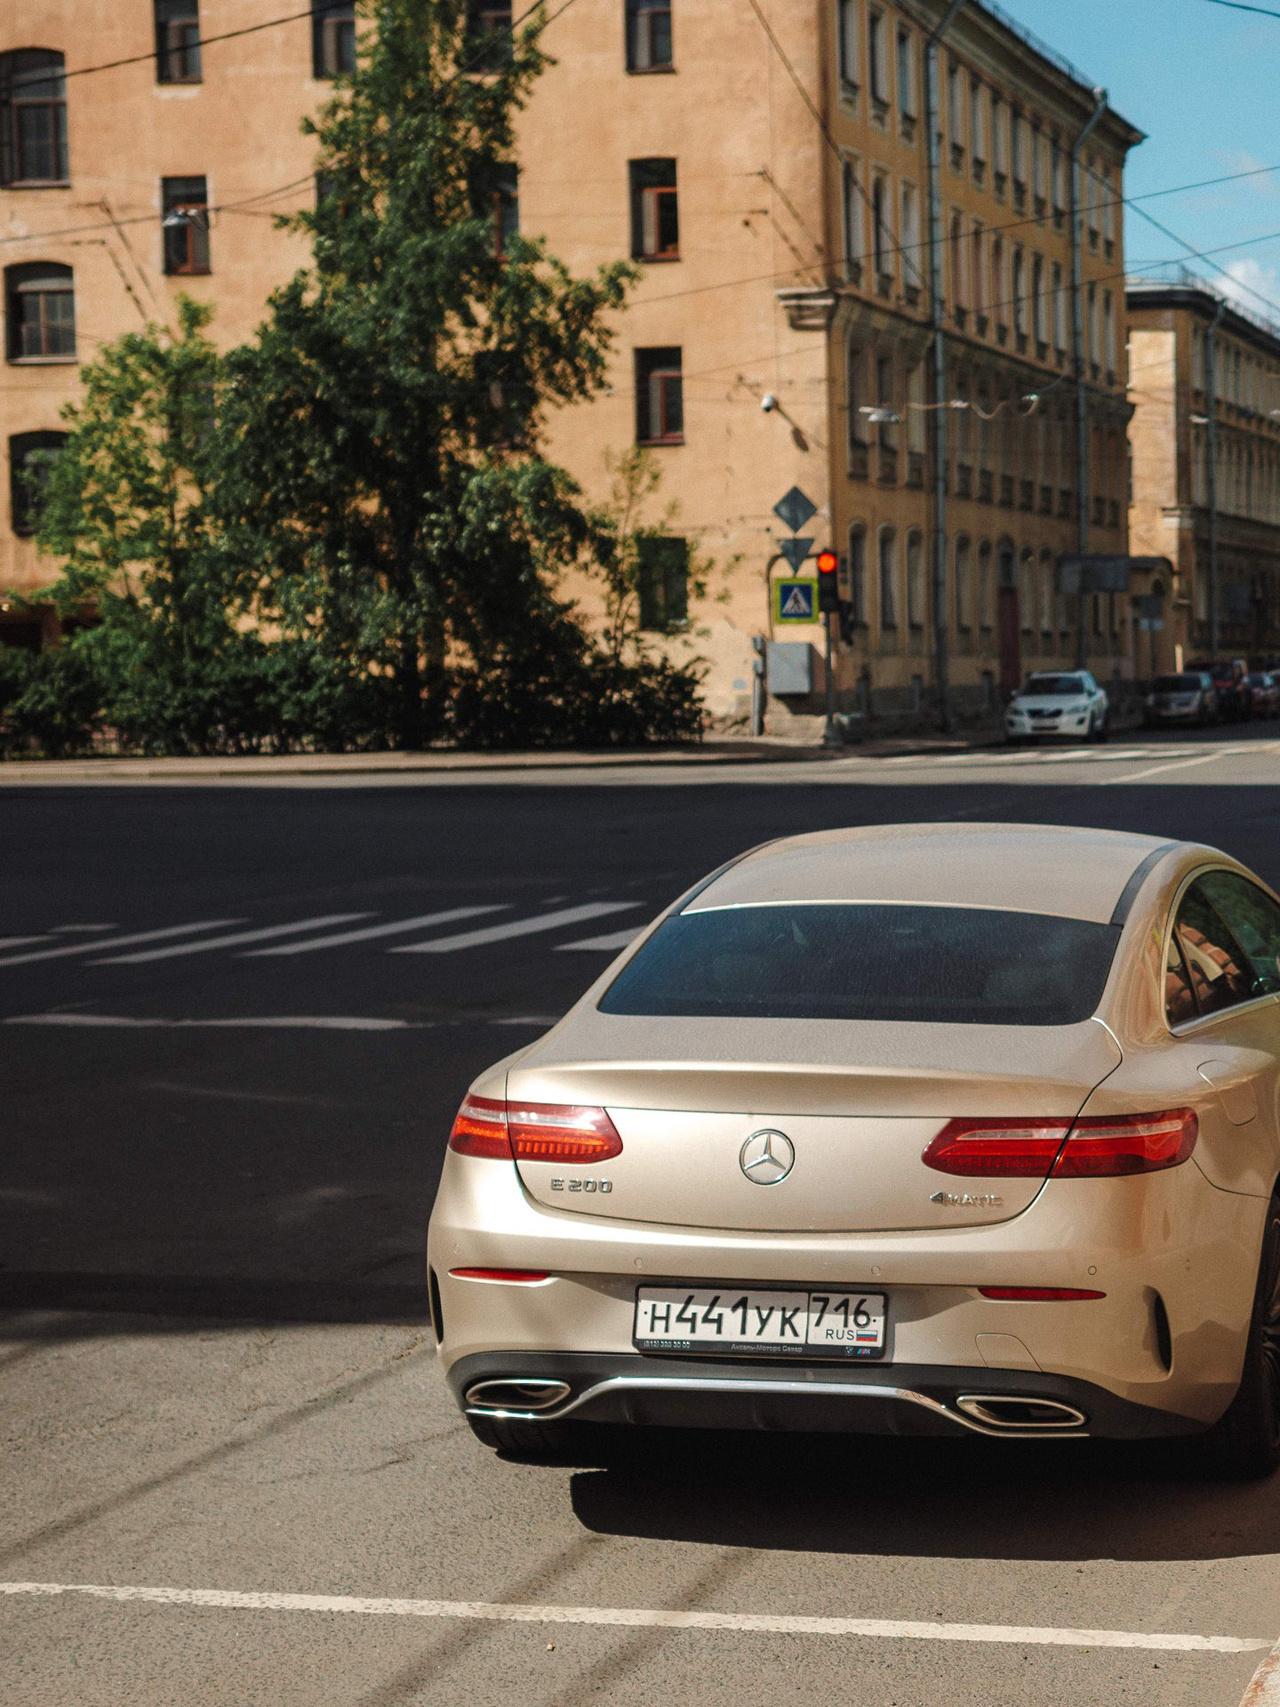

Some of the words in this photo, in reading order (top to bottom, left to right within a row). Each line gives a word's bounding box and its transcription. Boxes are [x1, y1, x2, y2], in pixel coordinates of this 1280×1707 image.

[551, 1178, 565, 1191] E
[568, 1178, 613, 1193] 200
[812, 1296, 871, 1329] 716
[825, 1328, 855, 1341] RUS
